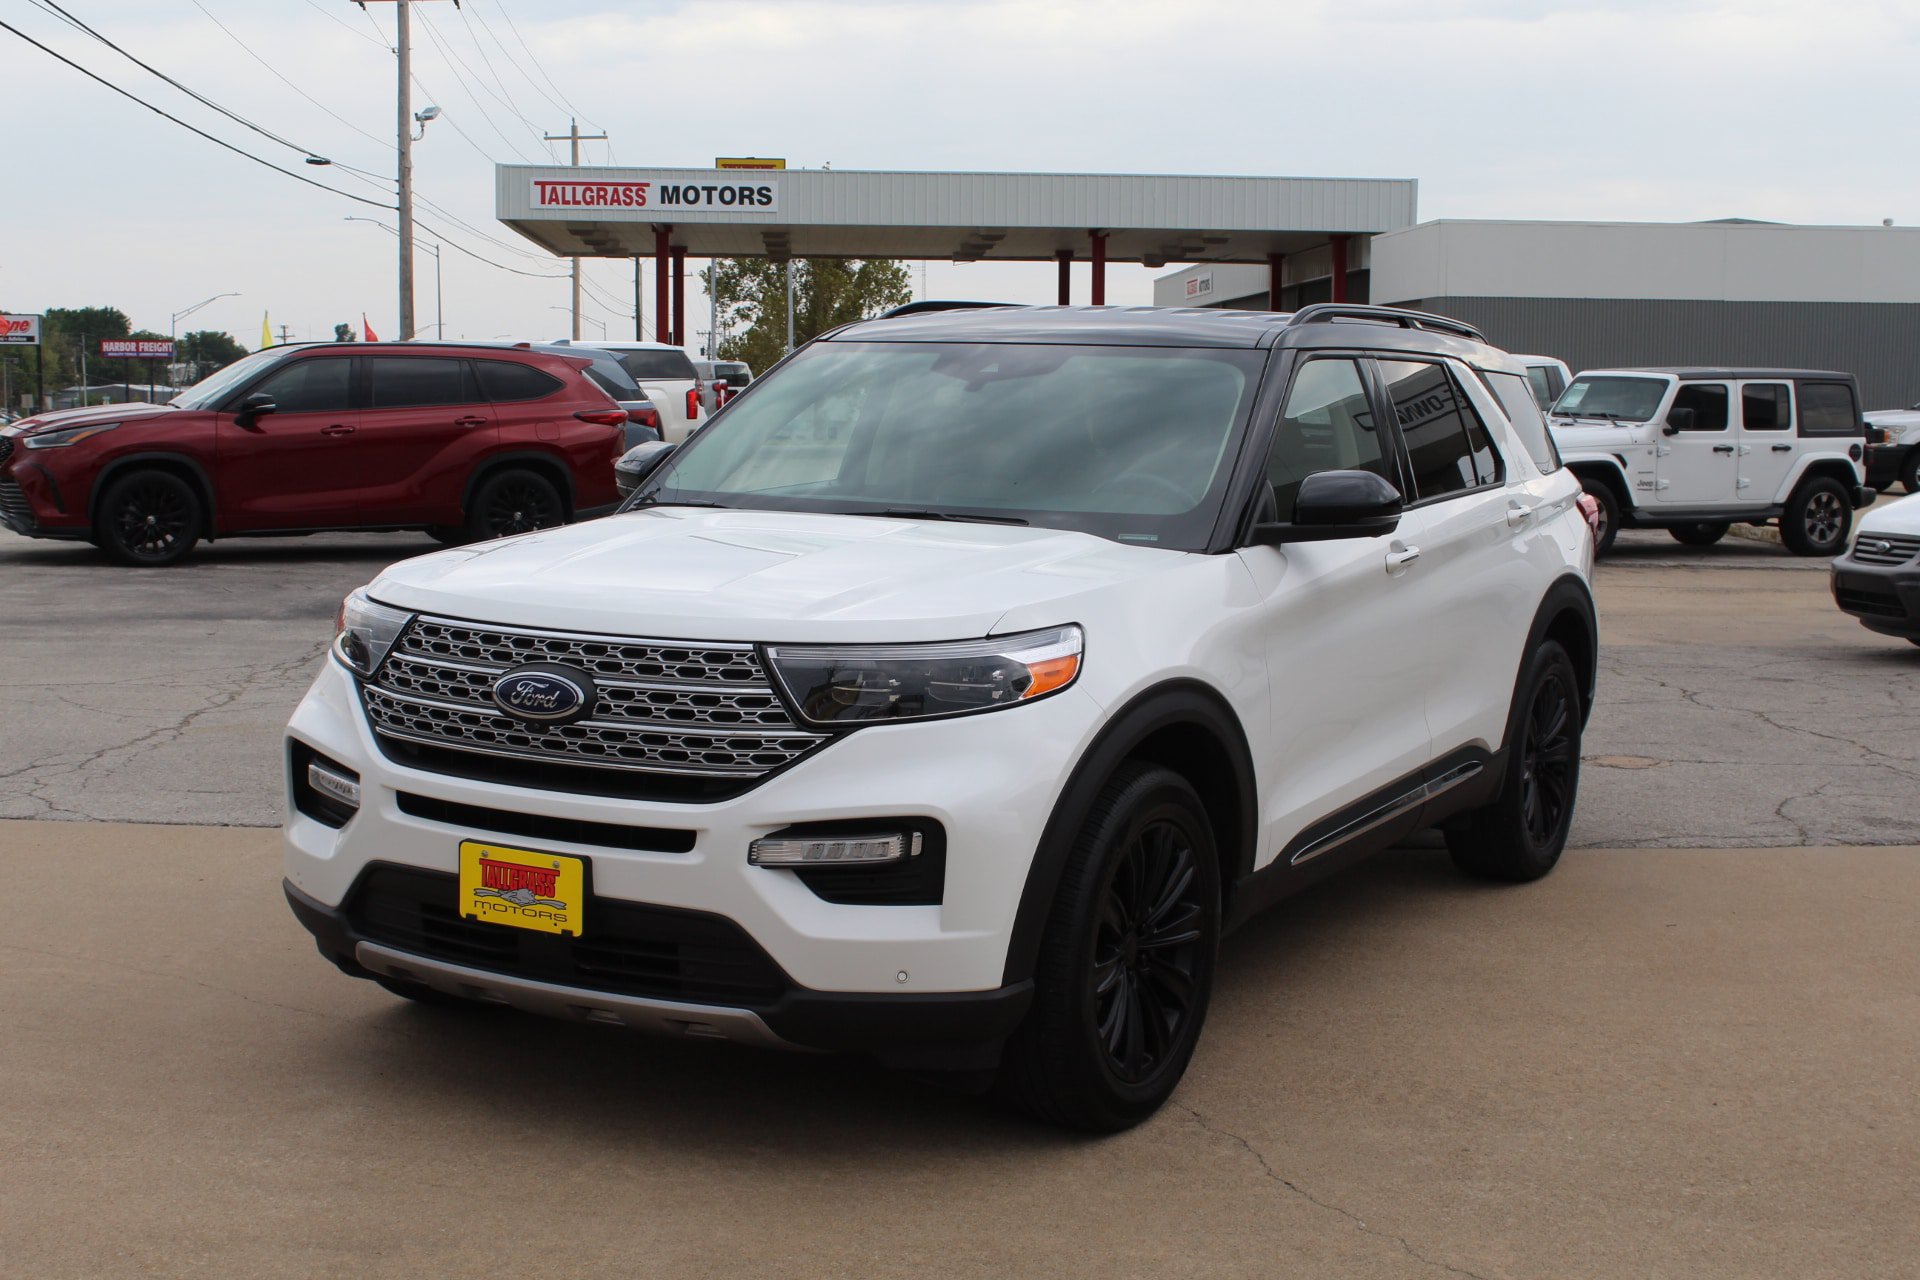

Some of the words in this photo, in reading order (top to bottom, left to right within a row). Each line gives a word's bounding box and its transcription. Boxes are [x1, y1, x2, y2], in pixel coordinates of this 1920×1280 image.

[534, 181, 650, 206] TALLGRASS
[660, 185, 773, 206] MOTORS
[103, 342, 136, 352] HARBOR
[138, 342, 173, 352] FREIGHT
[510, 680, 560, 708] Ford
[479, 858, 560, 898] TALLGRASS
[474, 900, 567, 922] MOTORS
